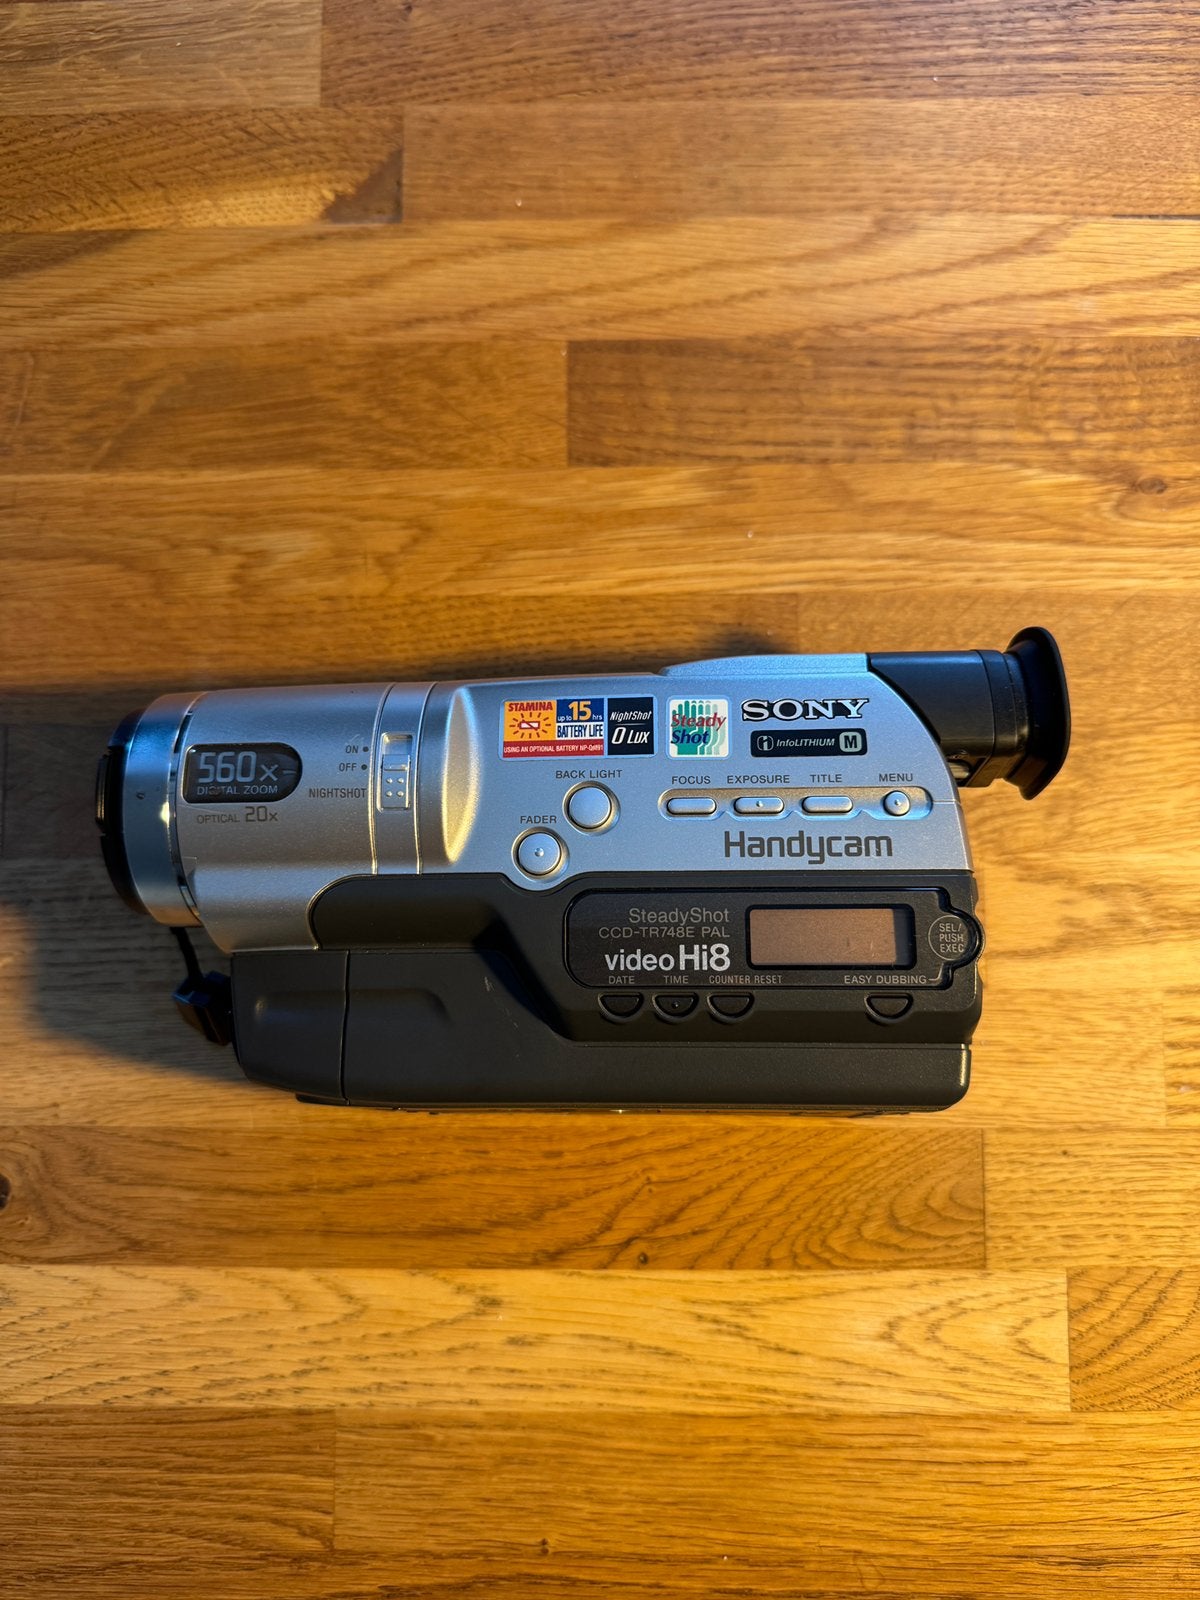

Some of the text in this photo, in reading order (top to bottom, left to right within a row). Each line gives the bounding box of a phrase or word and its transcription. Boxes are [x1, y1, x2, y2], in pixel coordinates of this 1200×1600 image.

[508, 701, 553, 712] STAMINA
[568, 701, 592, 721] 15
[742, 698, 869, 721] SONY
[609, 710, 652, 722] NightShot
[670, 712, 727, 731] Steady
[557, 724, 603, 738] BATTERY LIFE
[670, 729, 710, 744] Shot
[776, 738, 835, 747] InfoLITHIUM
[843, 735, 858, 749] M
[345, 745, 359, 754] ON
[555, 744, 579, 752] BATTERY
[338, 762, 357, 772] OFF
[555, 769, 623, 779] BACK LIGHT
[727, 774, 790, 784] EXPOSURE
[810, 774, 843, 783] TITLE
[879, 773, 914, 782] MENU
[671, 775, 711, 785] FOCUS
[243, 785, 278, 795] ZOOM
[308, 787, 367, 798] NIGHTSHOT
[196, 805, 278, 824] OPTICAL 20x
[520, 815, 557, 824] FADER
[724, 830, 893, 865] Handycam
[628, 907, 730, 926] SteadyShot
[599, 926, 730, 939] CCD-TR748E PAL
[939, 923, 962, 932] SEL/
[939, 933, 964, 943] PUSH
[940, 943, 964, 953] EXEC
[604, 943, 731, 972] video Hi8
[608, 975, 635, 984] DATE
[664, 975, 689, 984] TIME
[709, 975, 783, 984] COUNTER RESET
[844, 975, 927, 984] EASY DUBBING
